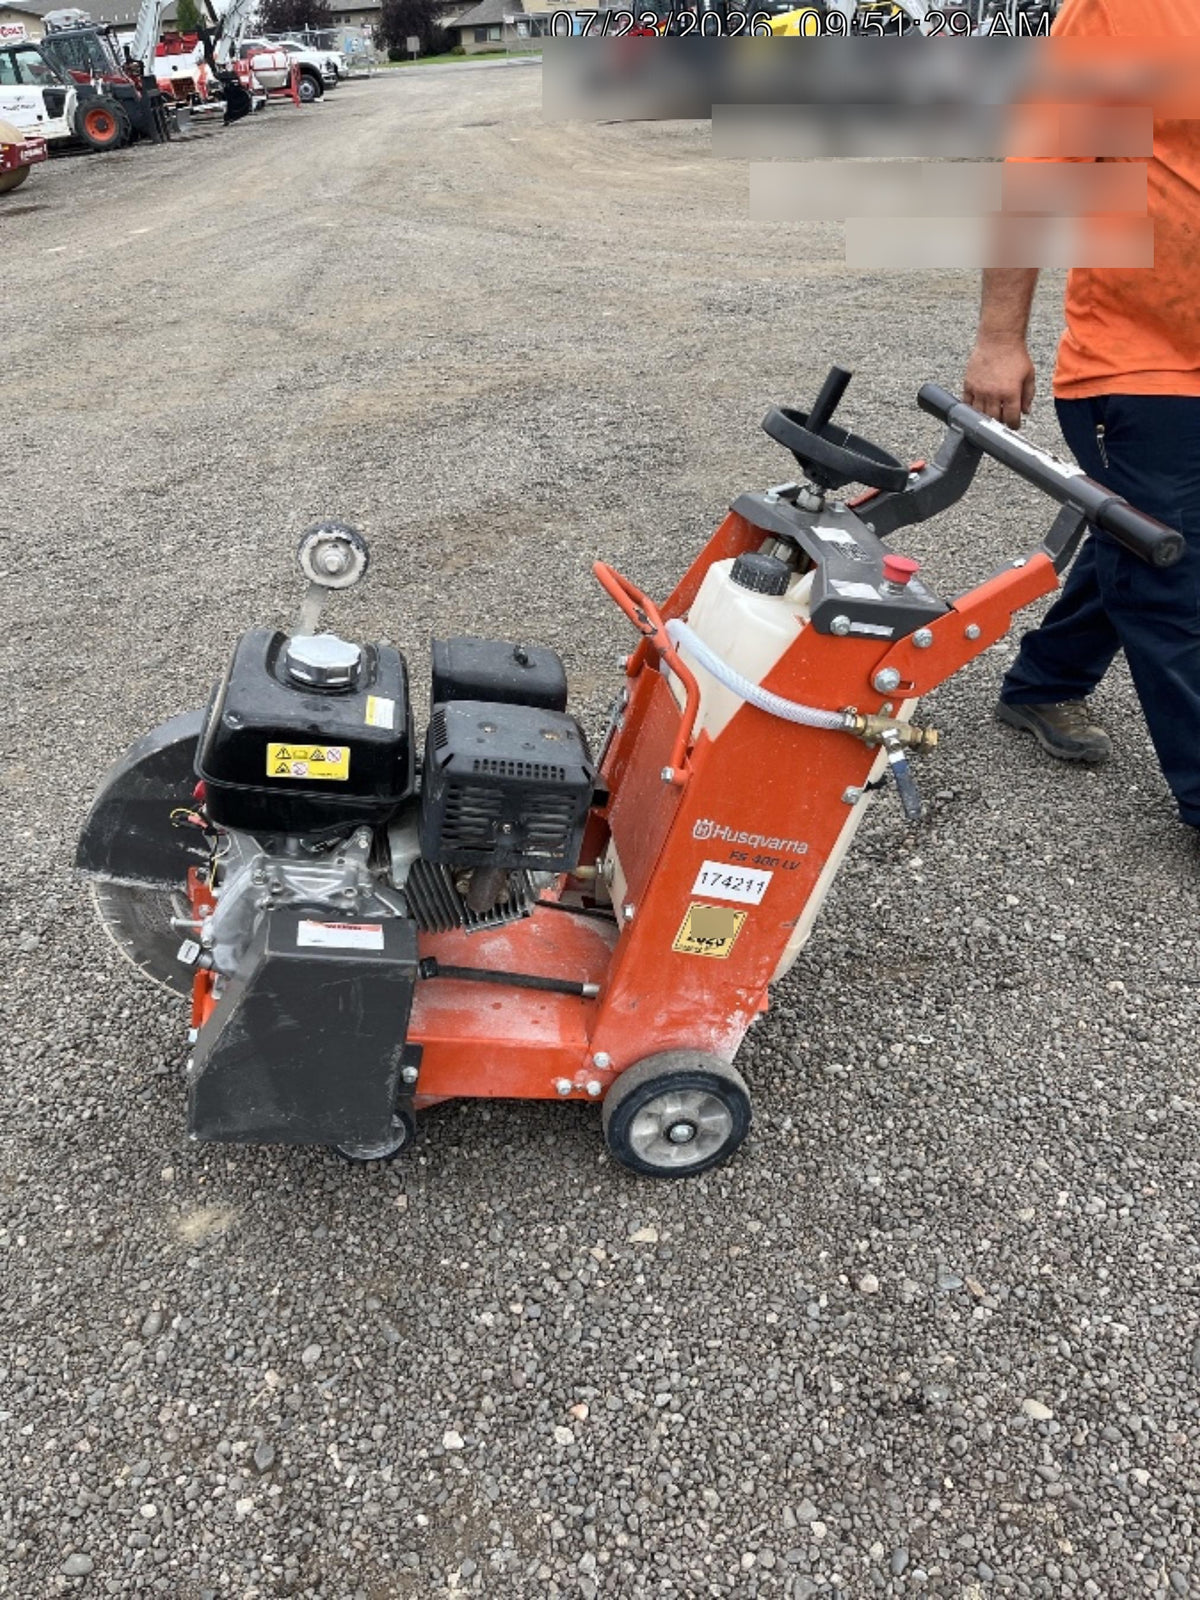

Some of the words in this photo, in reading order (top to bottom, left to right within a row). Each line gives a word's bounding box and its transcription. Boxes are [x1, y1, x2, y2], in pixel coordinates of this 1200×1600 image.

[713, 824, 808, 854] Husqvarna
[729, 851, 749, 862] FS
[752, 854, 779, 867] 400
[782, 860, 801, 870] LV
[701, 872, 766, 895] 174211
